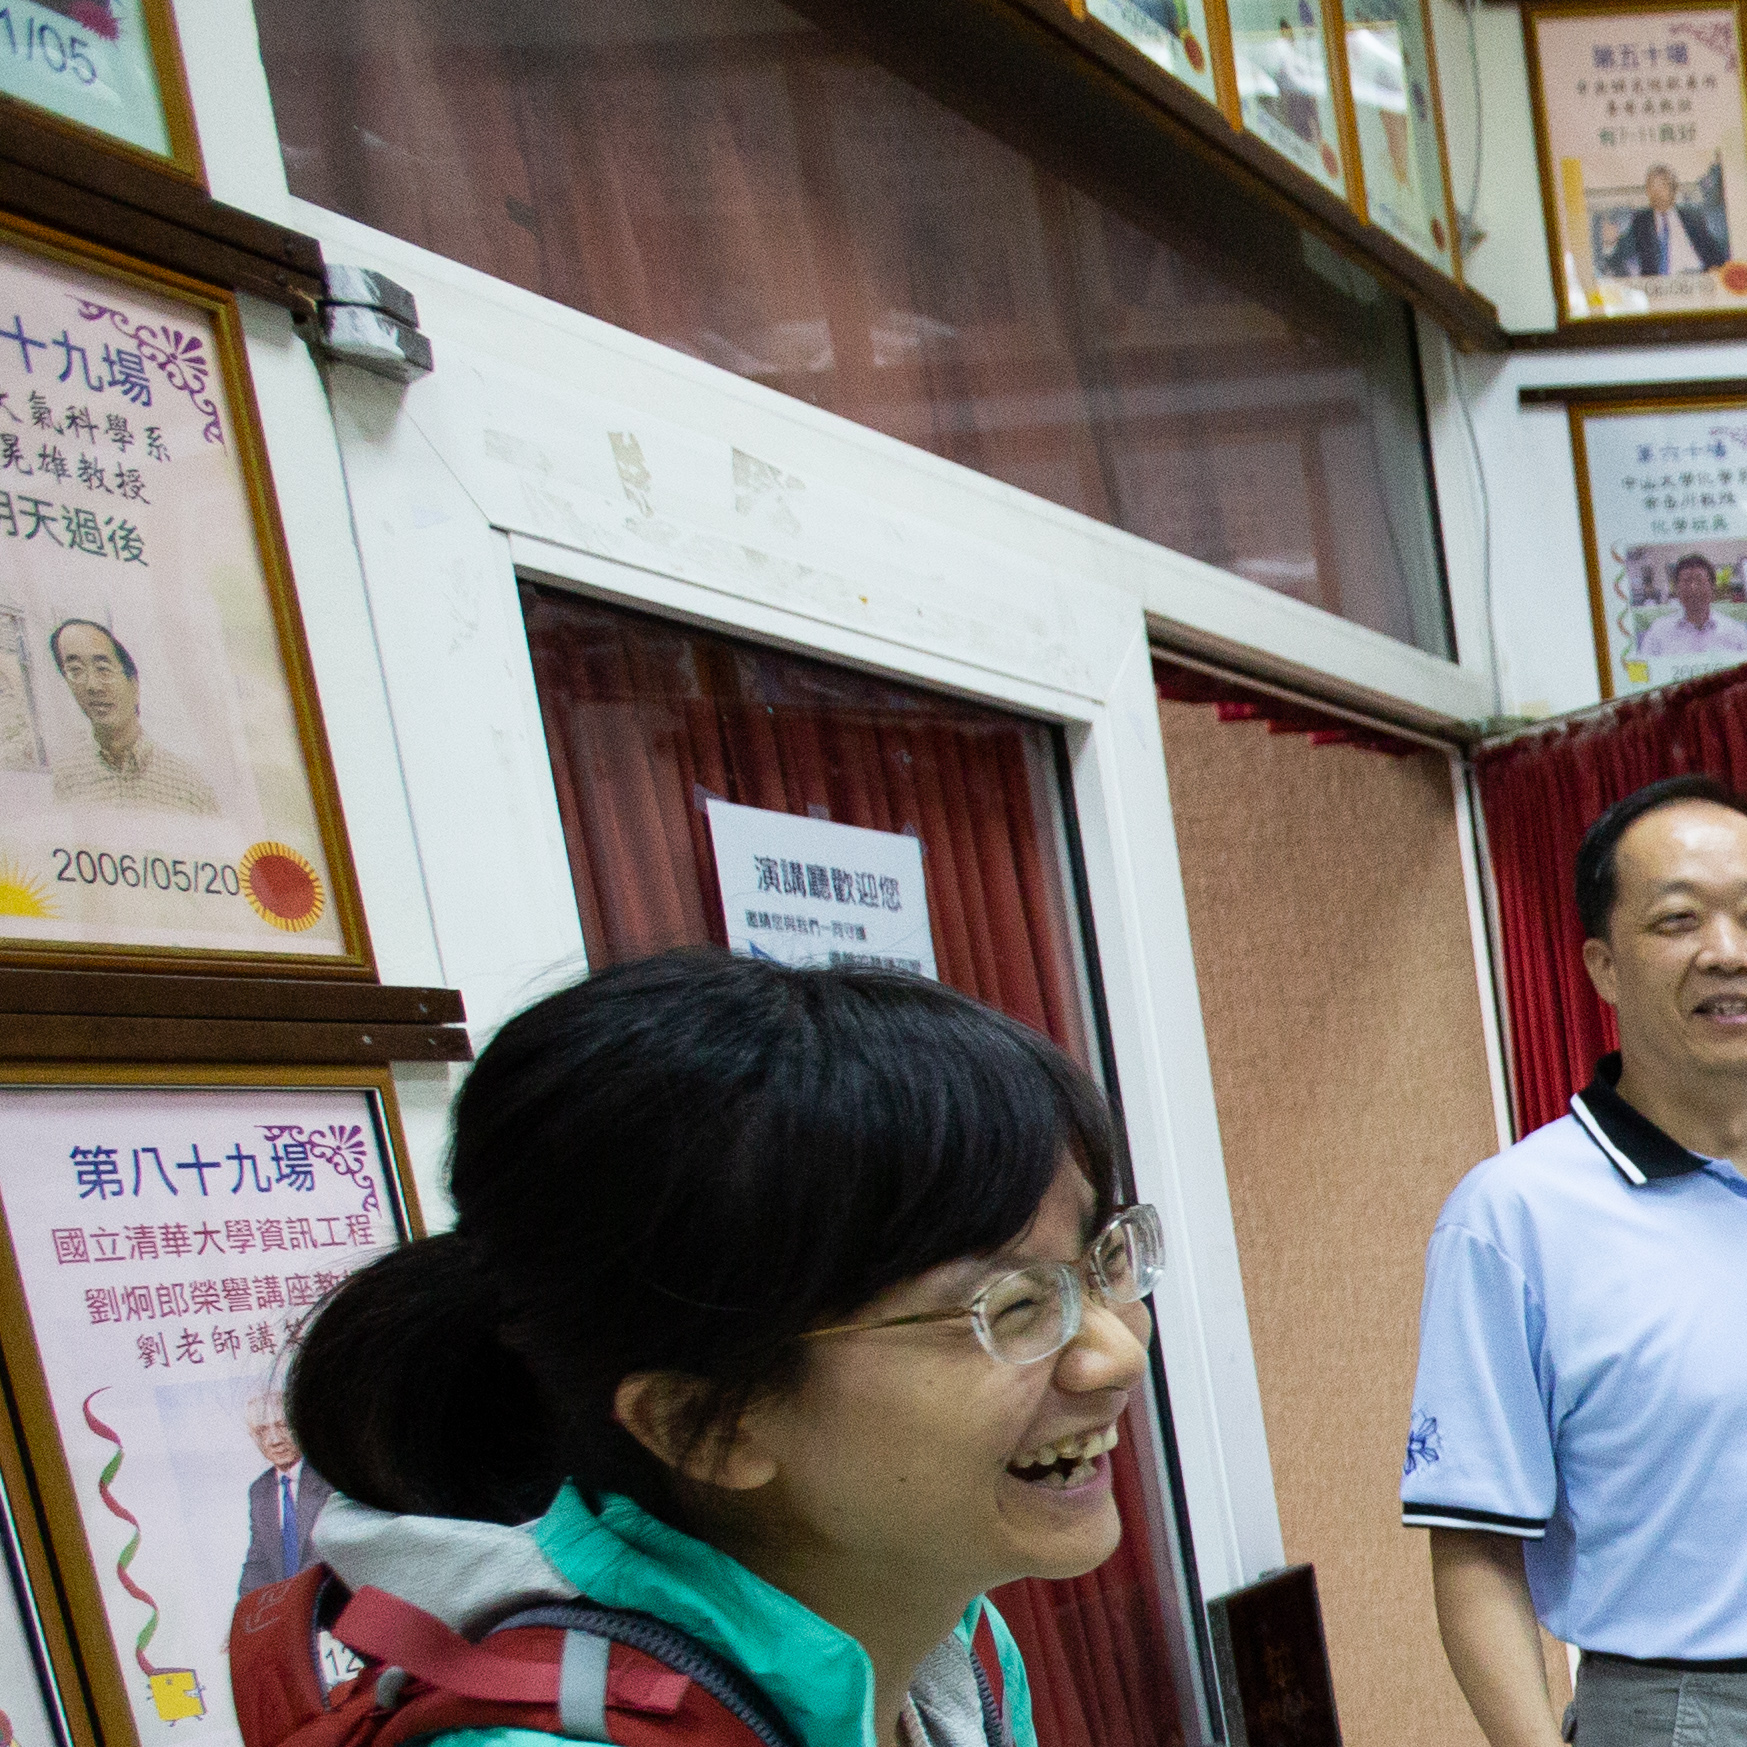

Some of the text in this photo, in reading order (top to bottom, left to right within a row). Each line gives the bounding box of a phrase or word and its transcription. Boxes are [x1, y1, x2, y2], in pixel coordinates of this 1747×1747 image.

[52, 847, 240, 898] 2006/05/20
[753, 854, 903, 914] 演講廳歡迎您
[69, 1142, 317, 1201] 第八十九場
[51, 1213, 378, 1267] 國立清華大學資訊工程
[83, 1270, 354, 1326] 劉炯郎榮譽講座教
